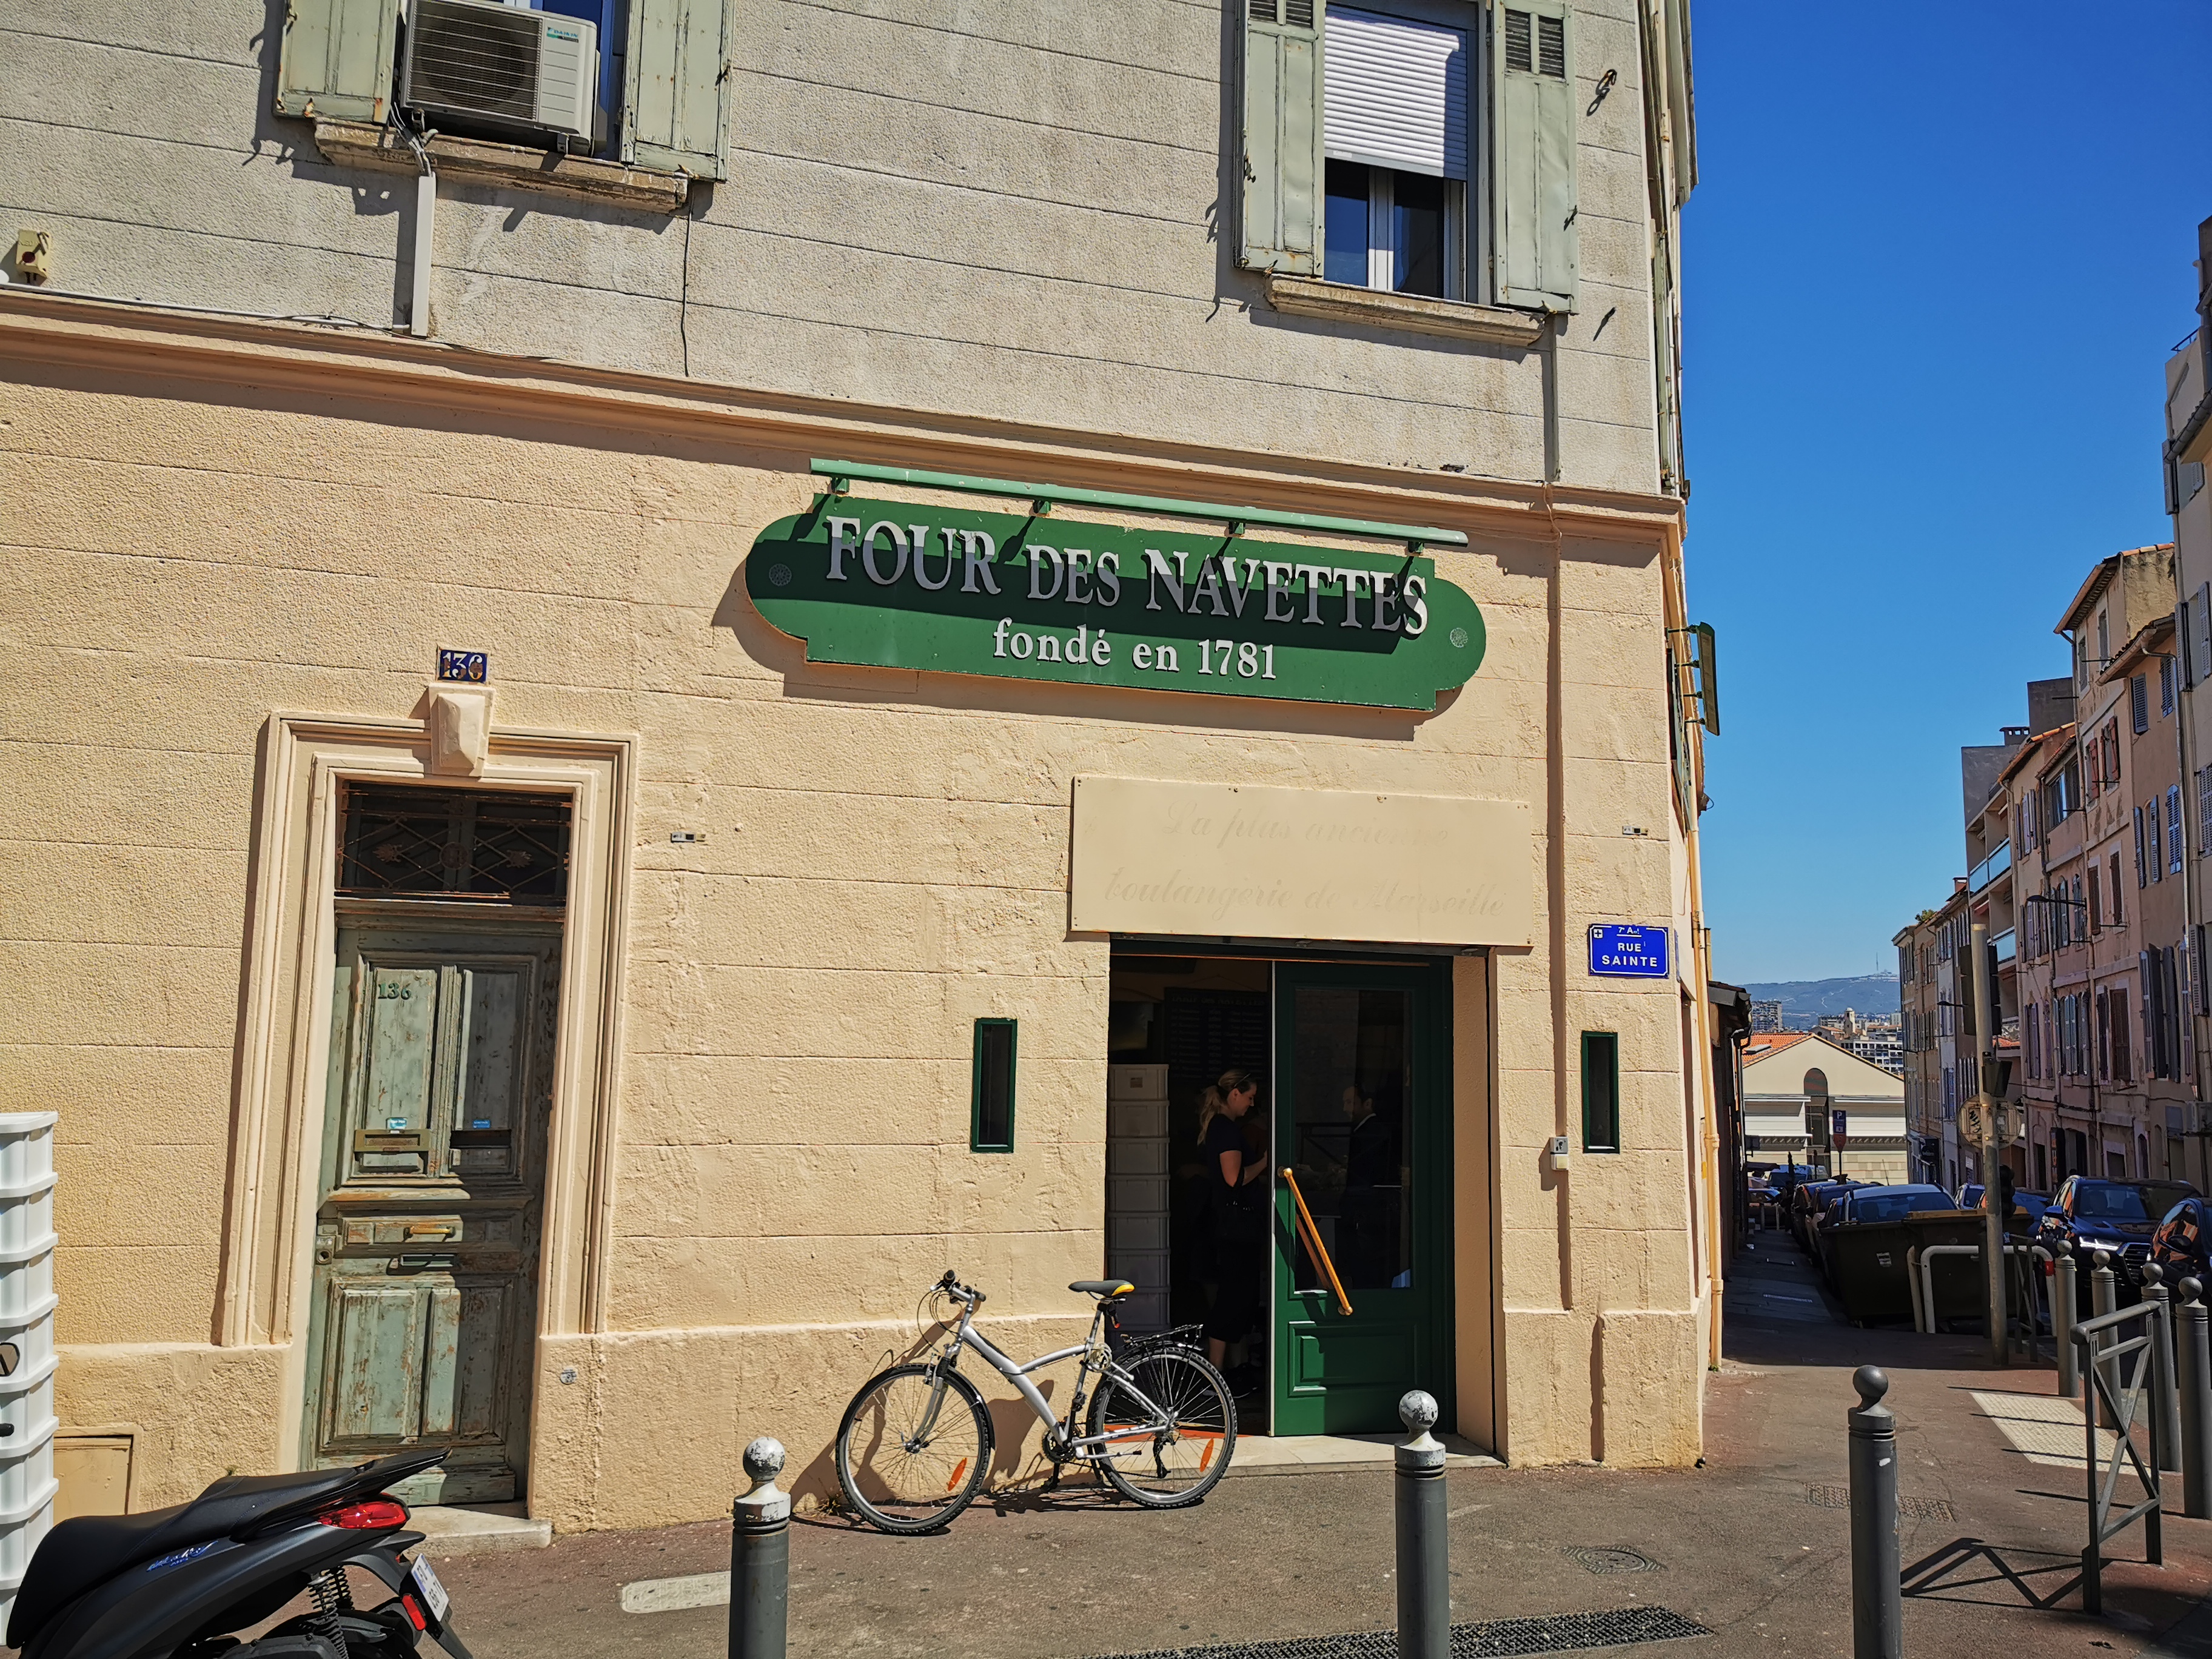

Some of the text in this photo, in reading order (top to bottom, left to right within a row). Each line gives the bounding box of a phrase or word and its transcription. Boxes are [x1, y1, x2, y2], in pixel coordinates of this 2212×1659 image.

[825, 515, 1429, 635] FOUR DES NAVETTES
[993, 617, 1276, 680] fondé en 1781
[443, 652, 483, 680] 136
[1161, 799, 1212, 836] La
[1216, 805, 1292, 849] plus
[1104, 866, 1504, 919] boulangerie de Marseille
[1601, 954, 1658, 967] SAINTE
[1617, 942, 1642, 952] RUE
[378, 982, 412, 1000] 136
[1837, 1111, 1843, 1119] P
